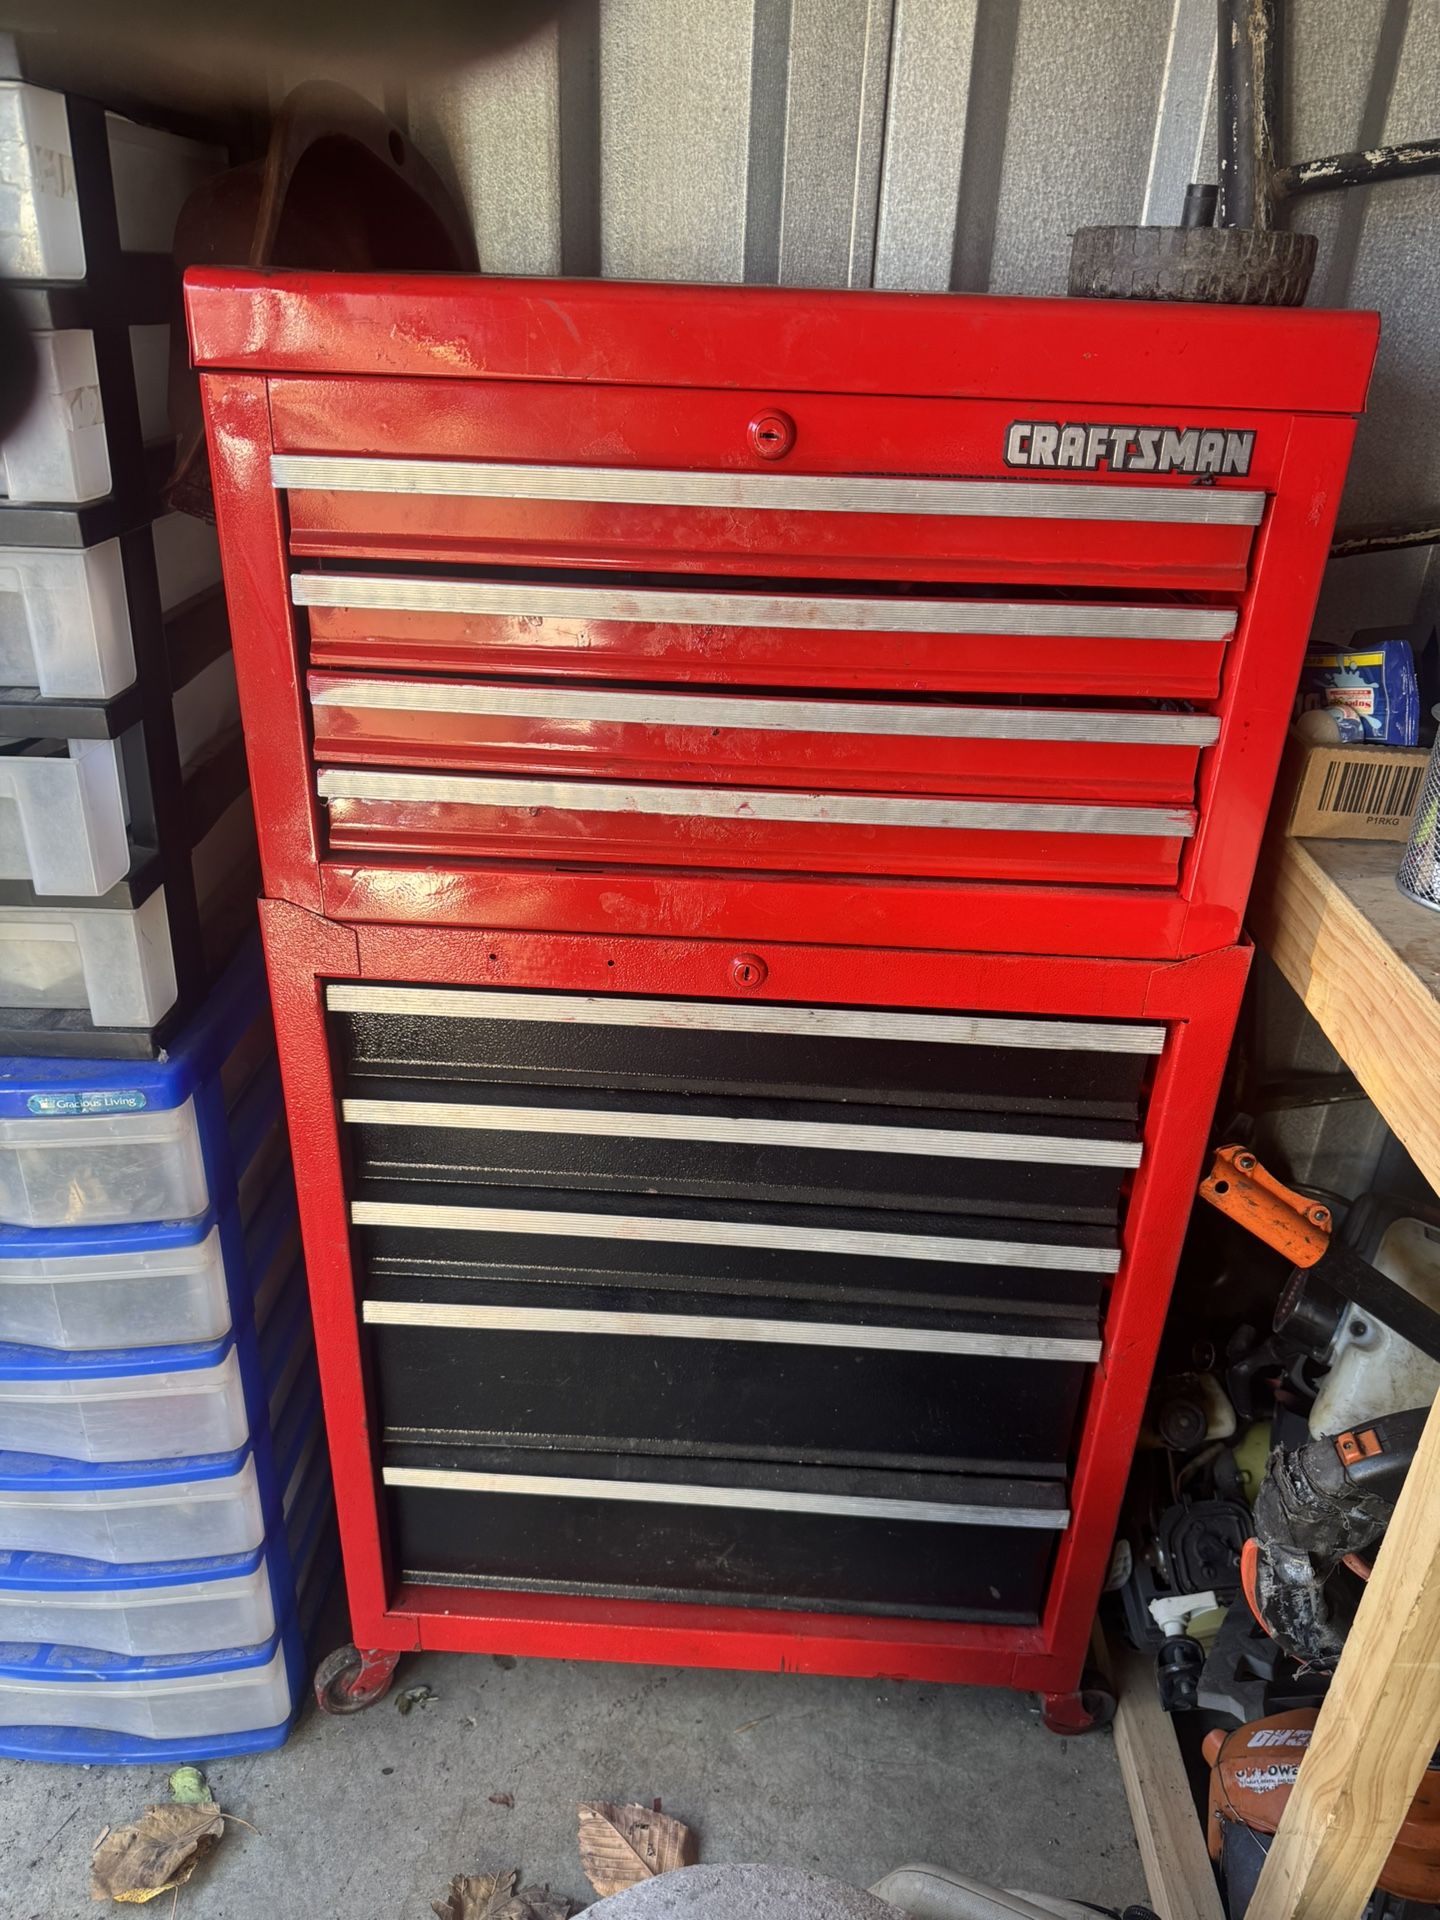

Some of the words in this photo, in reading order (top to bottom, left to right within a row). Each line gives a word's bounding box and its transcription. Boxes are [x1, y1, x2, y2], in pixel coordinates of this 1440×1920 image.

[1004, 421, 1257, 475] CRAFTSMAN
[1366, 816, 1400, 826] P1RKG
[56, 1099, 102, 1109] Gracious
[104, 1097, 137, 1107] Living
[1247, 1729, 1312, 1747] CHO
